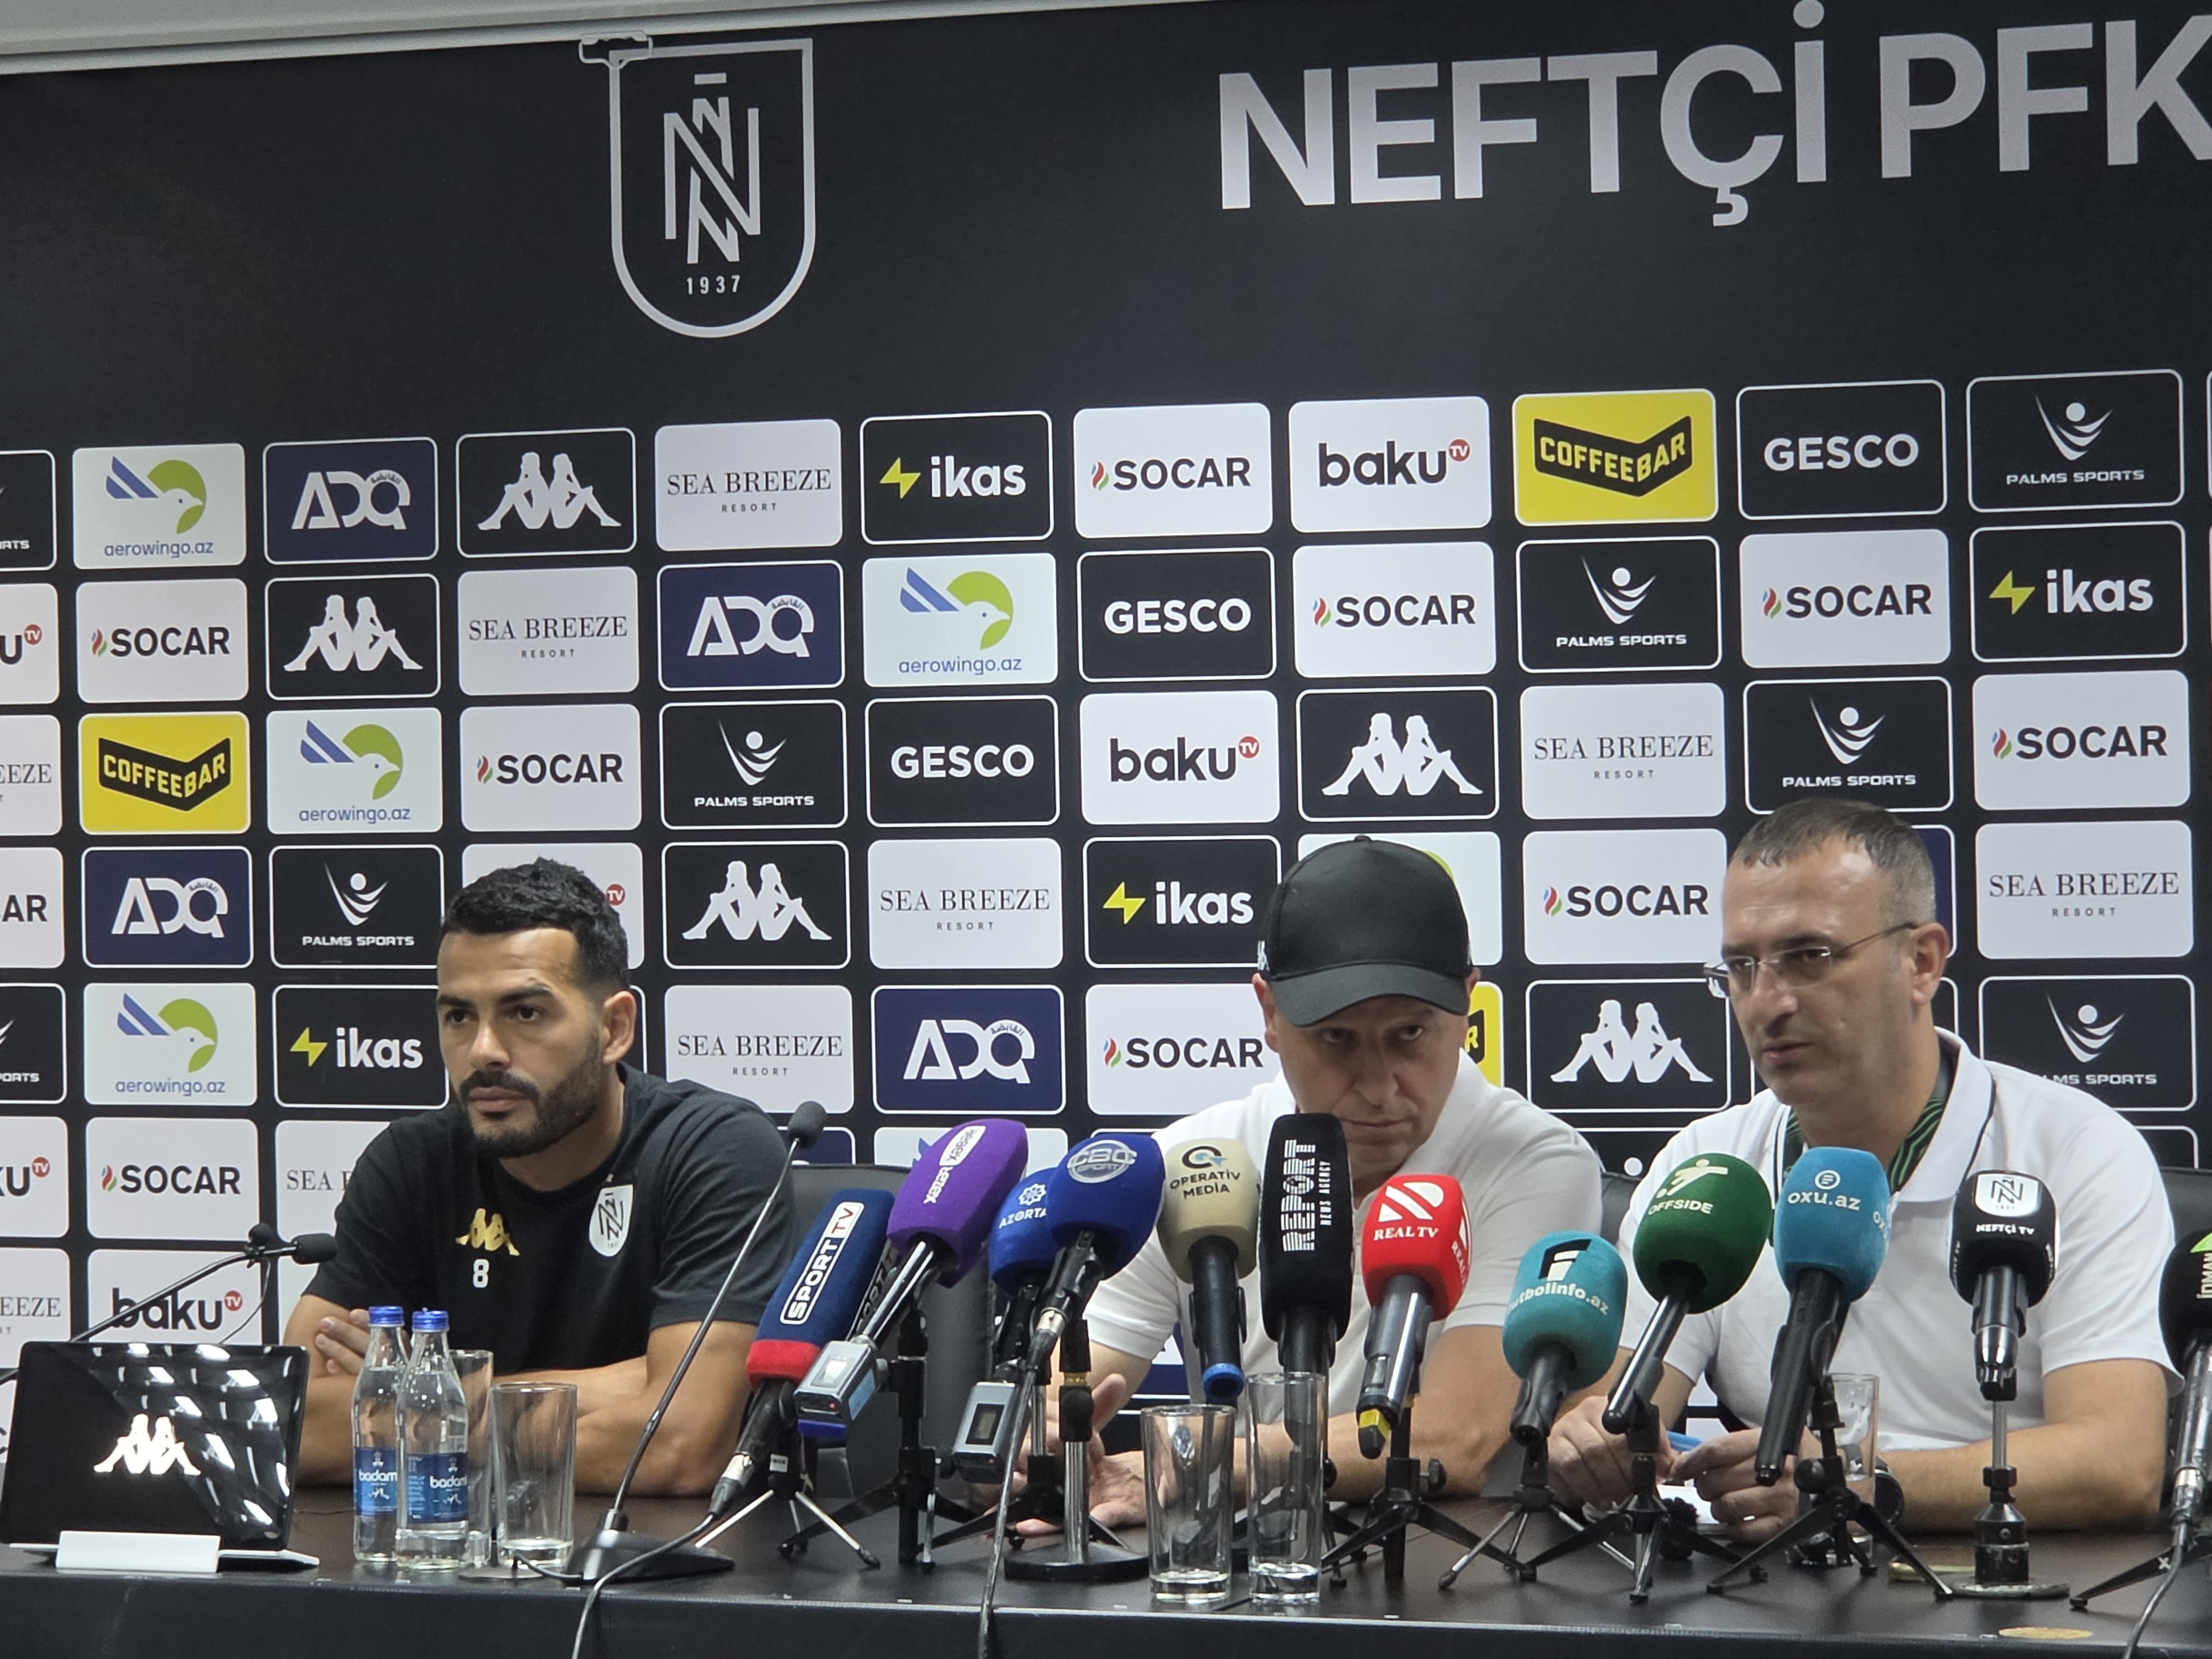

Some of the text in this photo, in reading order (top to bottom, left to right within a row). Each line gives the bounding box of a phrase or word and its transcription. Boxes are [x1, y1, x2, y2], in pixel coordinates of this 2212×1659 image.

[1219, 0, 2212, 227] NEFTÇİ PFK
[687, 275, 740, 294] 1937
[1319, 441, 1469, 487] baku TV
[1539, 431, 1686, 483] COFFEEBAR
[1764, 434, 1918, 471] GESCO
[668, 469, 831, 495] SEA BREEZE
[931, 456, 1026, 497] ikas
[1113, 457, 1250, 491] SOCAR
[2007, 470, 2144, 484] PALMS SPORTS
[291, 469, 410, 530] ADQ
[722, 503, 776, 512] RESORT
[105, 540, 213, 558] aerowingo.az
[1786, 585, 1932, 618] SOCAR
[2047, 569, 2153, 613] ikas
[1105, 598, 1251, 634] GESCO
[1335, 595, 1475, 627] SOCAR
[469, 617, 627, 640] SEA BREEZE
[687, 595, 814, 657] ADQ
[111, 627, 229, 656] SOCAR
[1557, 635, 1687, 647] PALMS SPORTS
[521, 649, 577, 658] RESORT
[899, 656, 1022, 675] aerowingo.az
[1535, 735, 1713, 759] SEA BREEZE
[2016, 726, 2167, 759] SOCAR
[497, 754, 622, 784] SOCAR
[891, 744, 1034, 778] GESCO
[1110, 737, 1259, 782] baku TV
[103, 753, 226, 799] COFFEEBAR
[1594, 770, 1653, 779] RESORT
[1783, 775, 1916, 787] PALMS SPORTS
[695, 796, 814, 806] PALMS SPORTS
[299, 806, 410, 824] aerowingo.az
[607, 889, 624, 901] TV
[1990, 873, 2178, 896] SEA BREEZE
[111, 878, 228, 938] ADQ
[881, 889, 1049, 911] SEA BREEZE
[1156, 881, 1254, 924] ikas
[1566, 885, 1708, 917] SOCAR
[2052, 907, 2115, 917] RESORT
[937, 922, 993, 930] RESORT
[302, 936, 414, 946] PALMS SPORTS
[337, 1027, 422, 1068] ikas
[679, 1036, 842, 1056] SEA BREEZE
[904, 1020, 1035, 1083] ADQ
[1126, 1037, 1264, 1068] SOCAR
[733, 1067, 787, 1076] RESORT
[2085, 1074, 2157, 1084] SPORTS
[116, 1078, 226, 1096] aerowingo.az
[32, 1161, 50, 1174] TV
[1067, 1147, 1137, 1169] CBC
[121, 1165, 240, 1194] SOCAR
[287, 1170, 332, 1190] SEA
[1169, 1168, 1241, 1190] OPERATİV
[1182, 1182, 1231, 1199] MEDİA
[1281, 1139, 1316, 1252] REPORT
[1648, 1199, 1713, 1215] OFFSIDE
[1788, 1191, 1861, 1211] oxu.az
[1374, 1227, 1439, 1241] REAL TV
[2018, 1226, 2035, 1234] TV
[473, 1259, 489, 1288] 8
[787, 1207, 854, 1320] SPORT TV
[112, 1287, 242, 1330] baku TV
